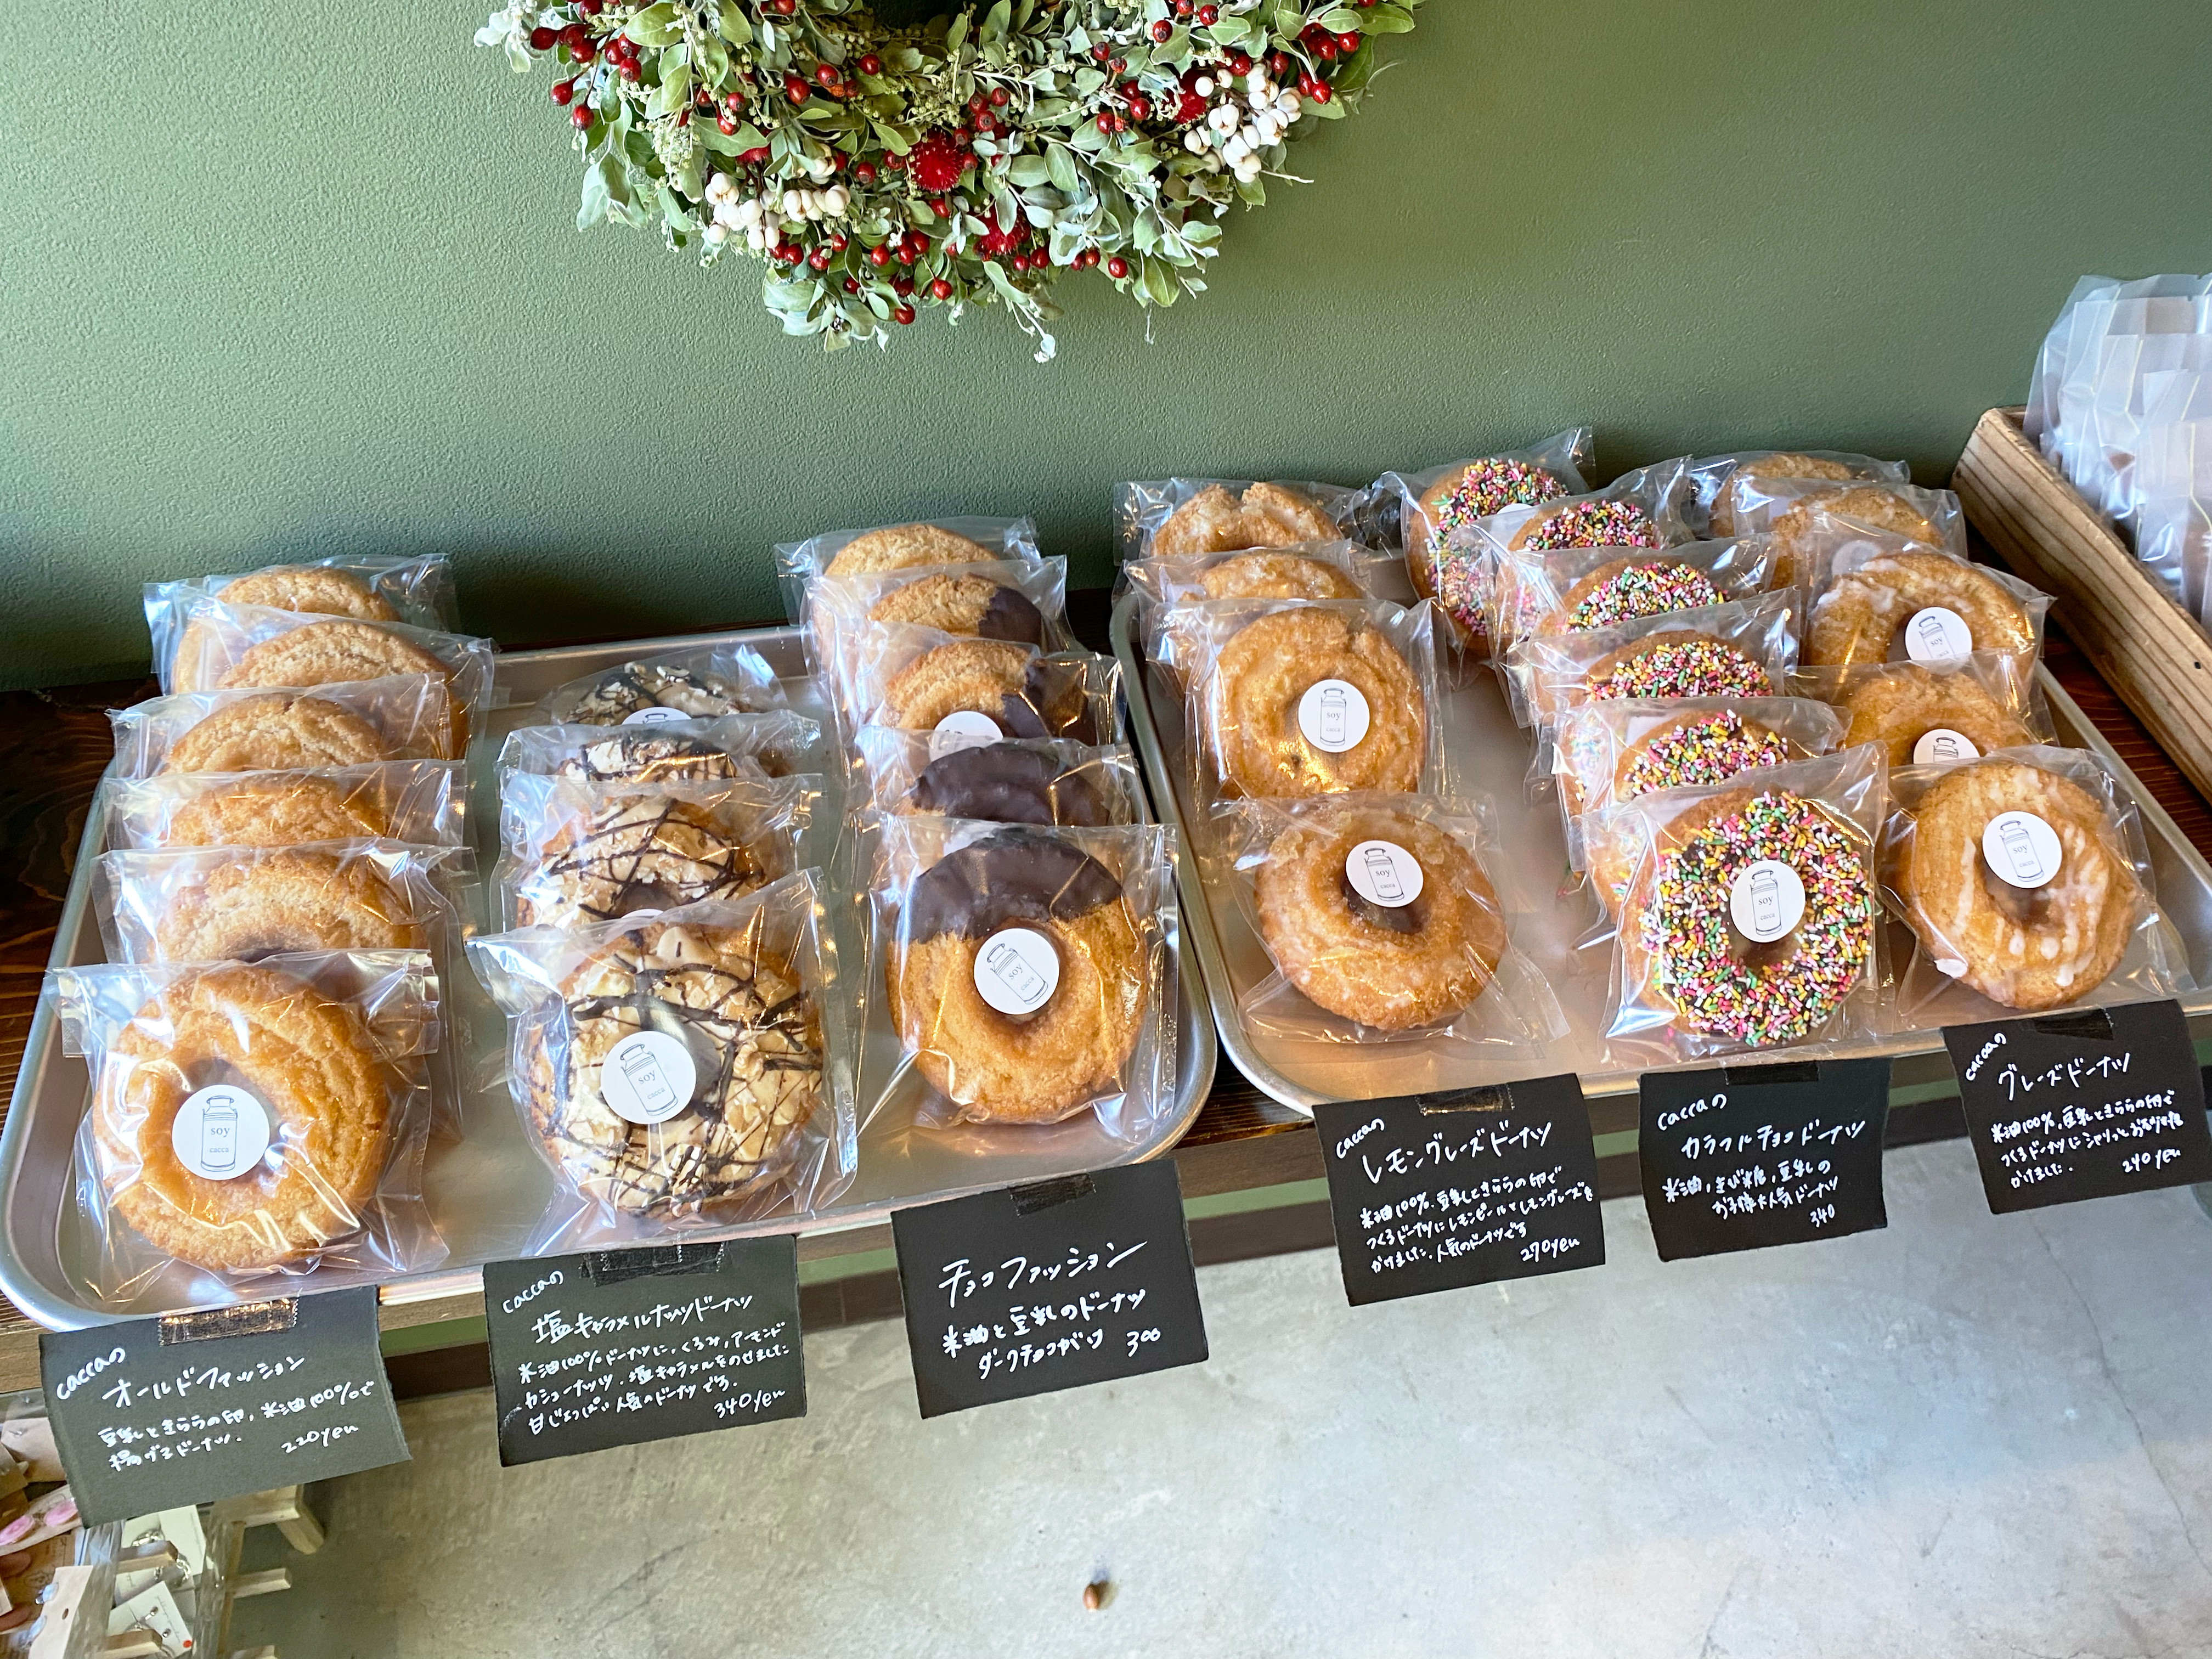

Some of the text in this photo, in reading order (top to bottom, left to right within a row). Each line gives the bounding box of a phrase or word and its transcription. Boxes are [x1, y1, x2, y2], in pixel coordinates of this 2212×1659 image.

[1327, 712, 1341, 720] soy
[2013, 844, 2028, 854] soy
[1758, 896, 1773, 905] soy
[1008, 963, 1023, 980] soy
[638, 1070, 655, 1085] soy
[1999, 1053, 2130, 1100] グレーズドーナツ
[211, 1127, 230, 1137] soy
[1681, 1119, 1865, 1159] カラフルチョコドーナツ
[1363, 1120, 1551, 1183] レモングレーズドーナツ
[1810, 1204, 1835, 1227] 340
[939, 1242, 1147, 1308] チョコファッション
[1127, 1328, 1160, 1357] 300
[102, 1357, 304, 1408] オールドファッション
